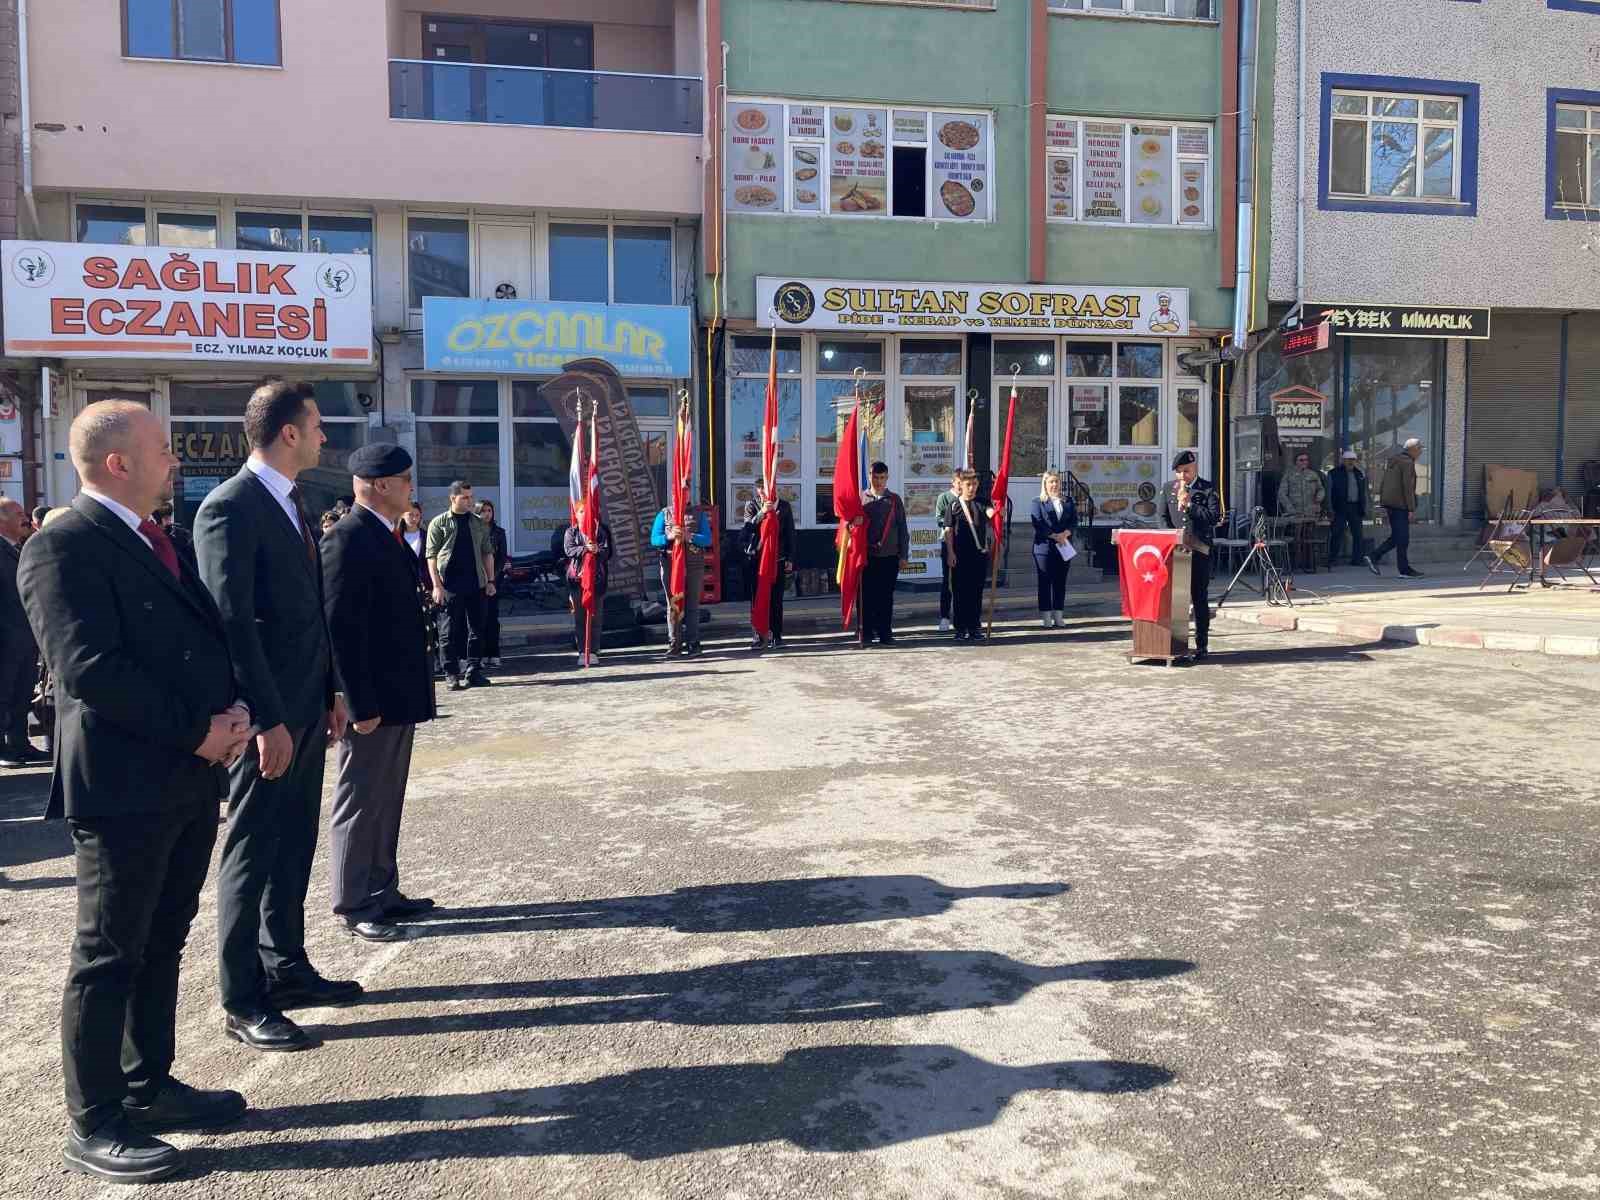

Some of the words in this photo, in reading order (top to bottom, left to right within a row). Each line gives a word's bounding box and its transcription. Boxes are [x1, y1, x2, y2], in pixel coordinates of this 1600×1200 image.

[82, 253, 297, 296] SAĞLIK
[821, 287, 969, 314] SULTAN
[977, 291, 1141, 318] SOFRASI
[50, 298, 328, 342] ECZANESİ
[838, 312, 884, 325] PİDE
[898, 314, 961, 327] KEBAP
[988, 317, 1050, 328] YEMEK
[1054, 317, 1134, 329] DÜNYASI
[1401, 311, 1473, 330] MİMARLIK
[195, 343, 223, 354] ECZ.
[227, 344, 274, 356] YILMAZ
[277, 346, 328, 359] KOÇLUK
